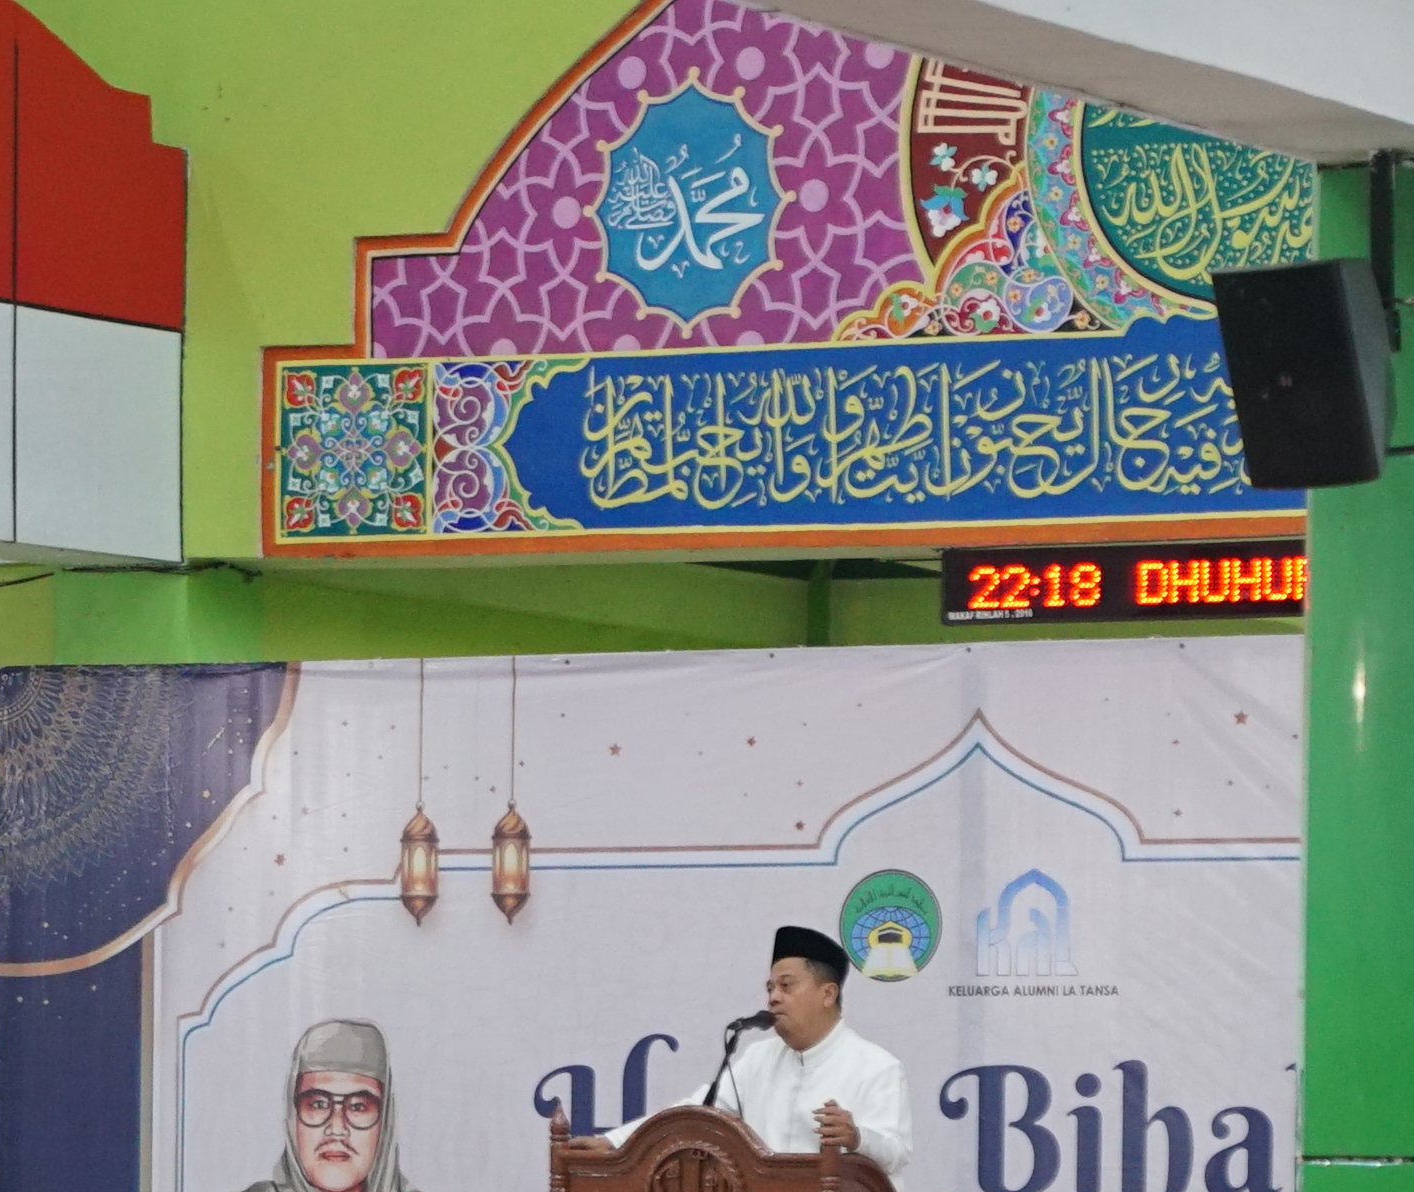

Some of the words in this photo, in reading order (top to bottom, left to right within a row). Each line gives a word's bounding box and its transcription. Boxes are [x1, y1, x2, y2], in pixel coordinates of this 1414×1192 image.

[968, 562, 1103, 610] 22:18
[948, 985, 1010, 997] KELUARGA
[1013, 985, 1059, 997] ALUMNI
[1062, 985, 1077, 997] LA
[1080, 985, 1120, 997] TANSA
